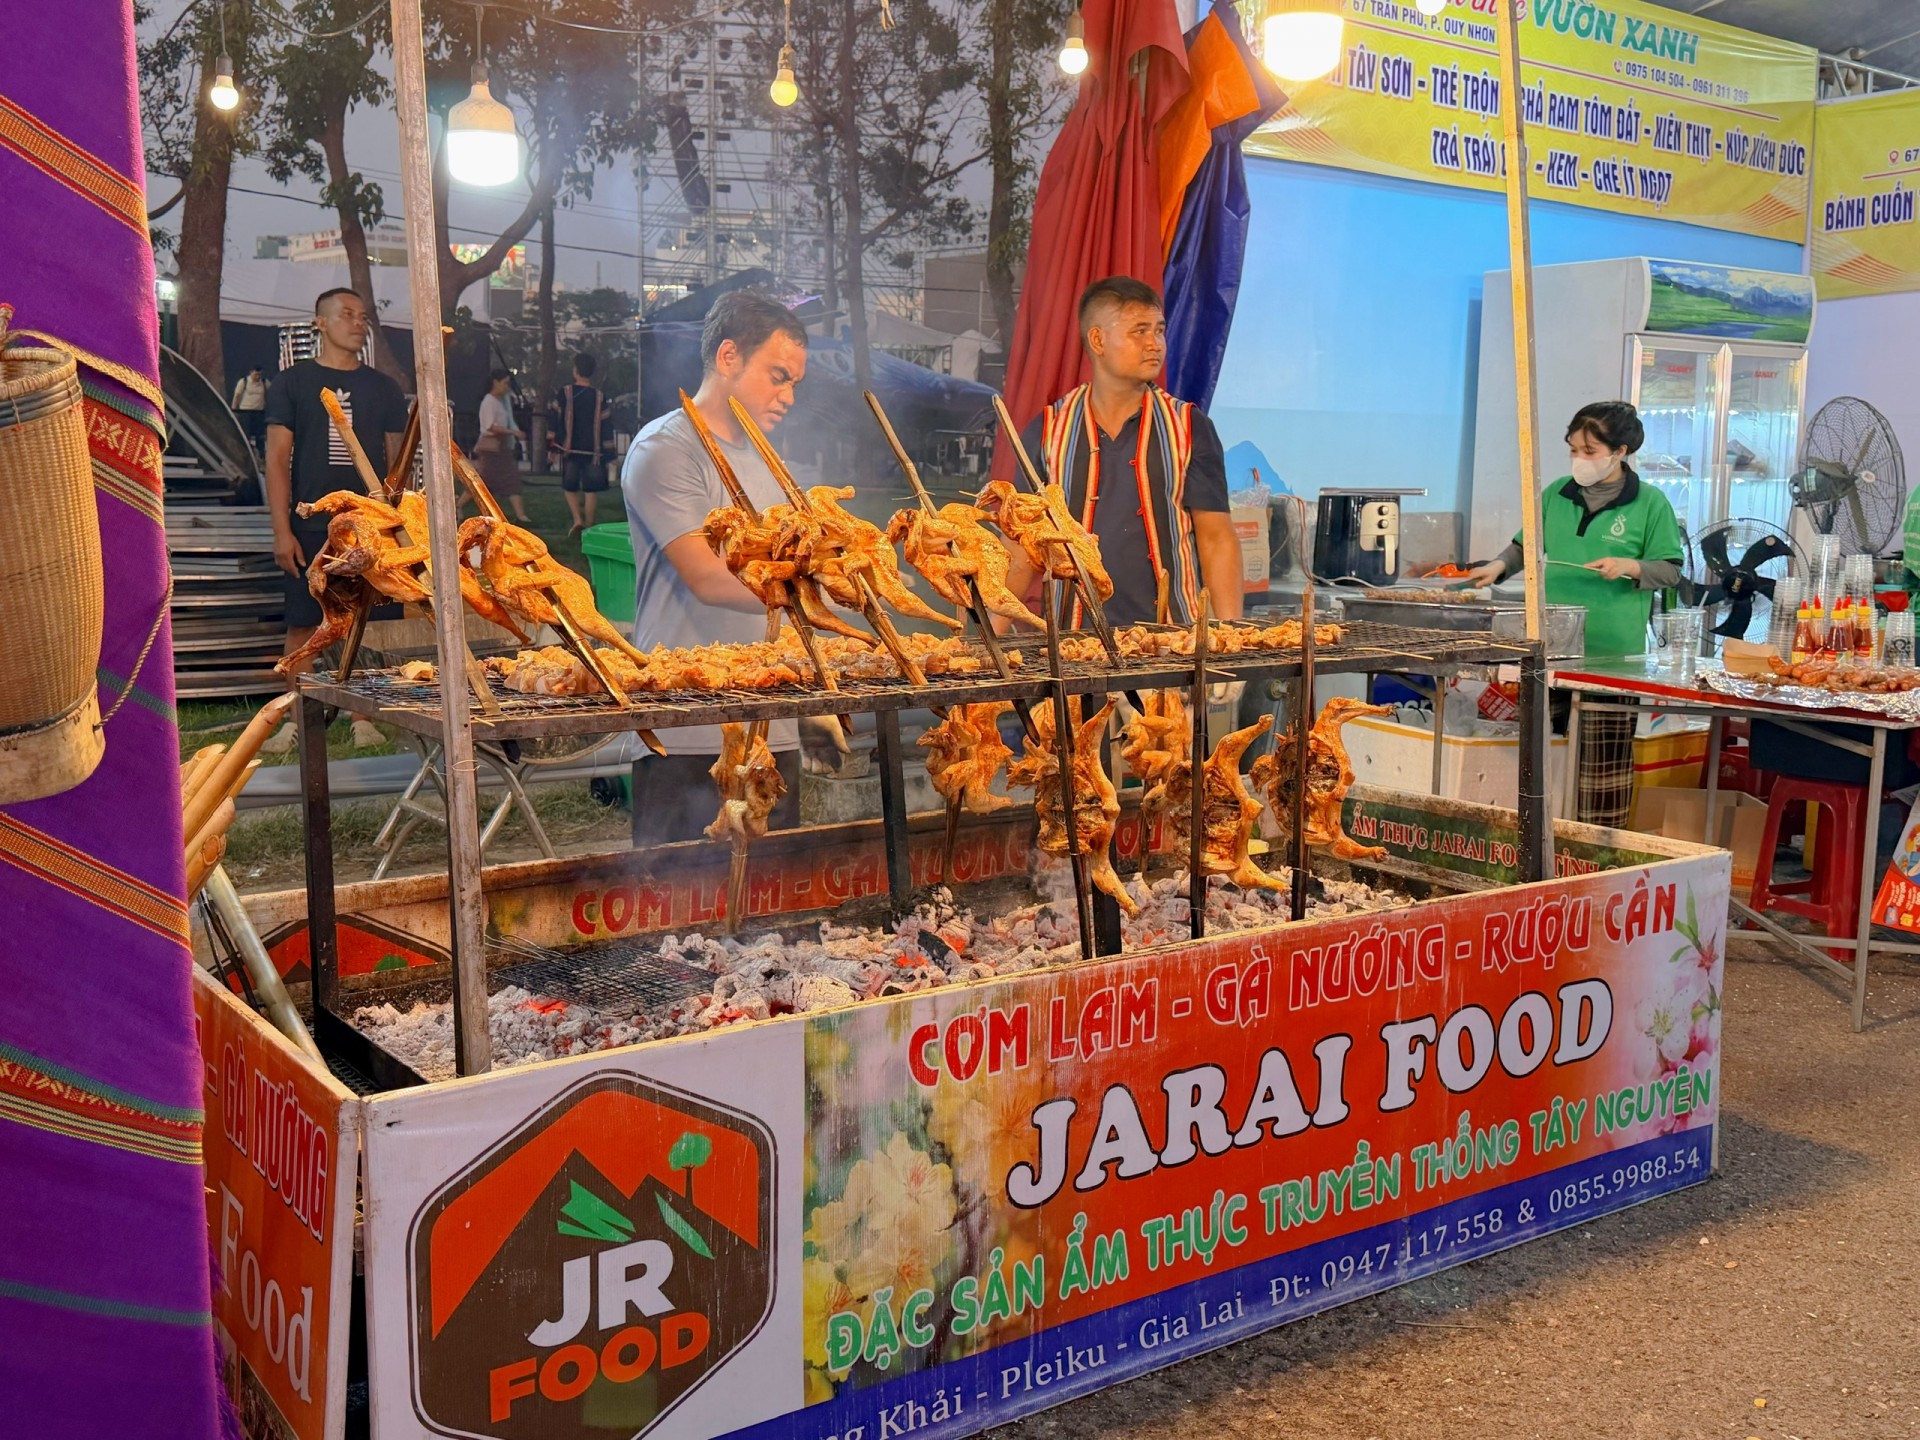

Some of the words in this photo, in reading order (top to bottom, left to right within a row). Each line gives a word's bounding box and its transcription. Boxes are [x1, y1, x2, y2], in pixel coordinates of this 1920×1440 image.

[1430, 15, 1442, 32] P.
[1444, 17, 1465, 36] QUY
[1468, 25, 1496, 43] NHƠN
[1621, 15, 1699, 65] XANH
[1625, 62, 1648, 79] 0975
[1650, 68, 1666, 84] 104
[1668, 72, 1684, 88] 504
[1692, 78, 1713, 95] 0961
[1715, 84, 1730, 98] 311
[1348, 44, 1377, 91] TÂY
[1380, 56, 1412, 97] SƠN
[1432, 64, 1458, 106] TRÉ
[1463, 71, 1499, 121] TRỘN
[1547, 97, 1579, 132] RAM
[1583, 95, 1612, 136] TÔM
[1616, 98, 1640, 144] ĐẤT
[1653, 113, 1681, 153] XIÊN
[1686, 124, 1711, 164] THỊT
[1726, 121, 1749, 163] XÚC
[1750, 131, 1777, 170] XÍCH
[1778, 139, 1806, 175] ĐỨC
[1904, 148, 1920, 162] 67
[1431, 125, 1460, 168] TRÀ
[1463, 132, 1497, 175] TRÁI
[1547, 151, 1578, 188] KEM
[1593, 157, 1618, 195] CHÈ
[1622, 159, 1635, 197] ÍT
[1639, 169, 1673, 209] NGỌT
[1825, 194, 1866, 231] BÁNH
[1871, 181, 1913, 226] CUỐN
[1350, 802, 1377, 840] ẨM
[1380, 819, 1428, 853] THỰC
[908, 1003, 1030, 1087] CƠM
[1048, 977, 1159, 1062] LAM
[1204, 945, 1272, 1029] GÀ
[1288, 922, 1446, 1012] NƯỚNG
[1481, 894, 1593, 973] RƯỢU
[1602, 868, 1677, 946] CẦN
[222, 1036, 248, 1158] GÀ
[252, 1068, 329, 1244] NƯỚNG
[1005, 1031, 1353, 1210] JARAI
[1377, 977, 1614, 1113] FOOD
[824, 1286, 936, 1374] ĐẶC
[951, 1246, 1045, 1336] SẢN
[1059, 1211, 1130, 1300] ẨM
[1141, 1189, 1248, 1272] THỰC
[1259, 1139, 1401, 1236] TRUYỀN
[1411, 1109, 1520, 1193] THỐNG
[1529, 1095, 1588, 1156] TÂY
[1594, 1065, 1713, 1137] NGUYÊN
[218, 1180, 314, 1405] Food
[526, 1238, 676, 1349] JR
[877, 1386, 965, 1440] Khải
[1000, 1343, 1108, 1400] Pleiku
[1138, 1314, 1191, 1351] Gia
[1199, 1291, 1245, 1331] Lai
[1268, 1274, 1313, 1307] Đt:
[1320, 1208, 1504, 1291] 0947.117.558
[1516, 1197, 1536, 1226] &
[1548, 1145, 1702, 1215] 0855.9988.54
[488, 1311, 712, 1424] FOOD
